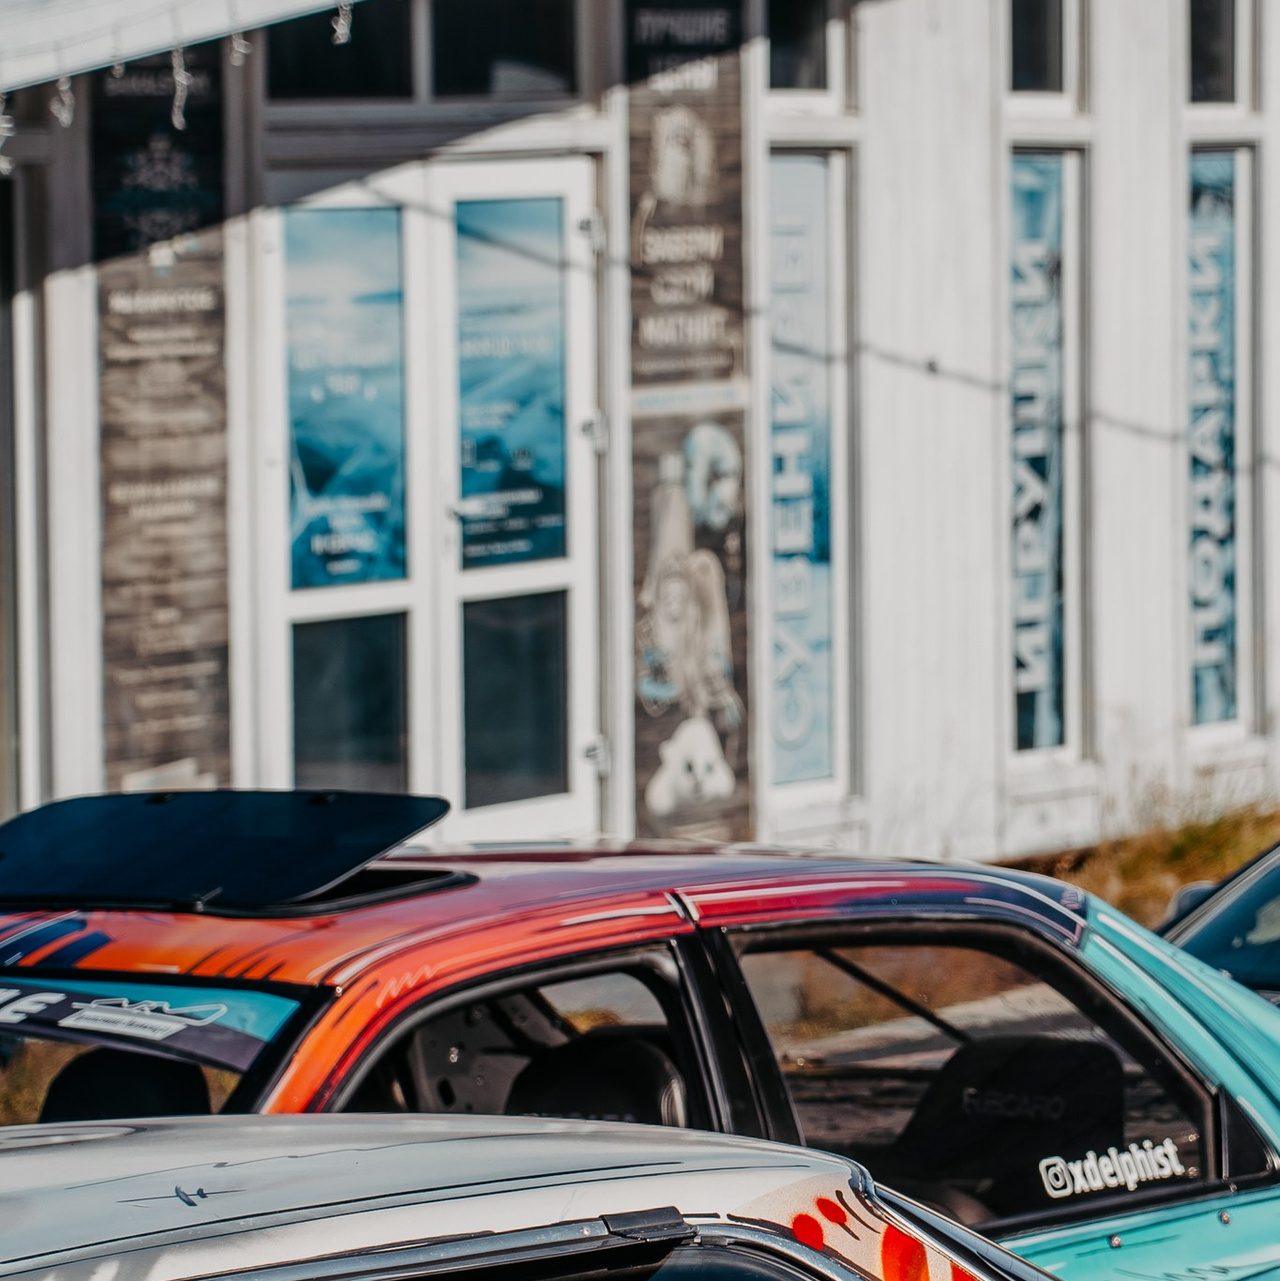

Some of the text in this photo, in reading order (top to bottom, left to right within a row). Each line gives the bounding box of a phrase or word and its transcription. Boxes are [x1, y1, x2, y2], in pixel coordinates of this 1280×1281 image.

[771, 222, 812, 751] СУВЕНИРЫ
[1012, 238, 1048, 695] ИГРУШКИ
[1190, 233, 1223, 667] ПОДАРКИ
